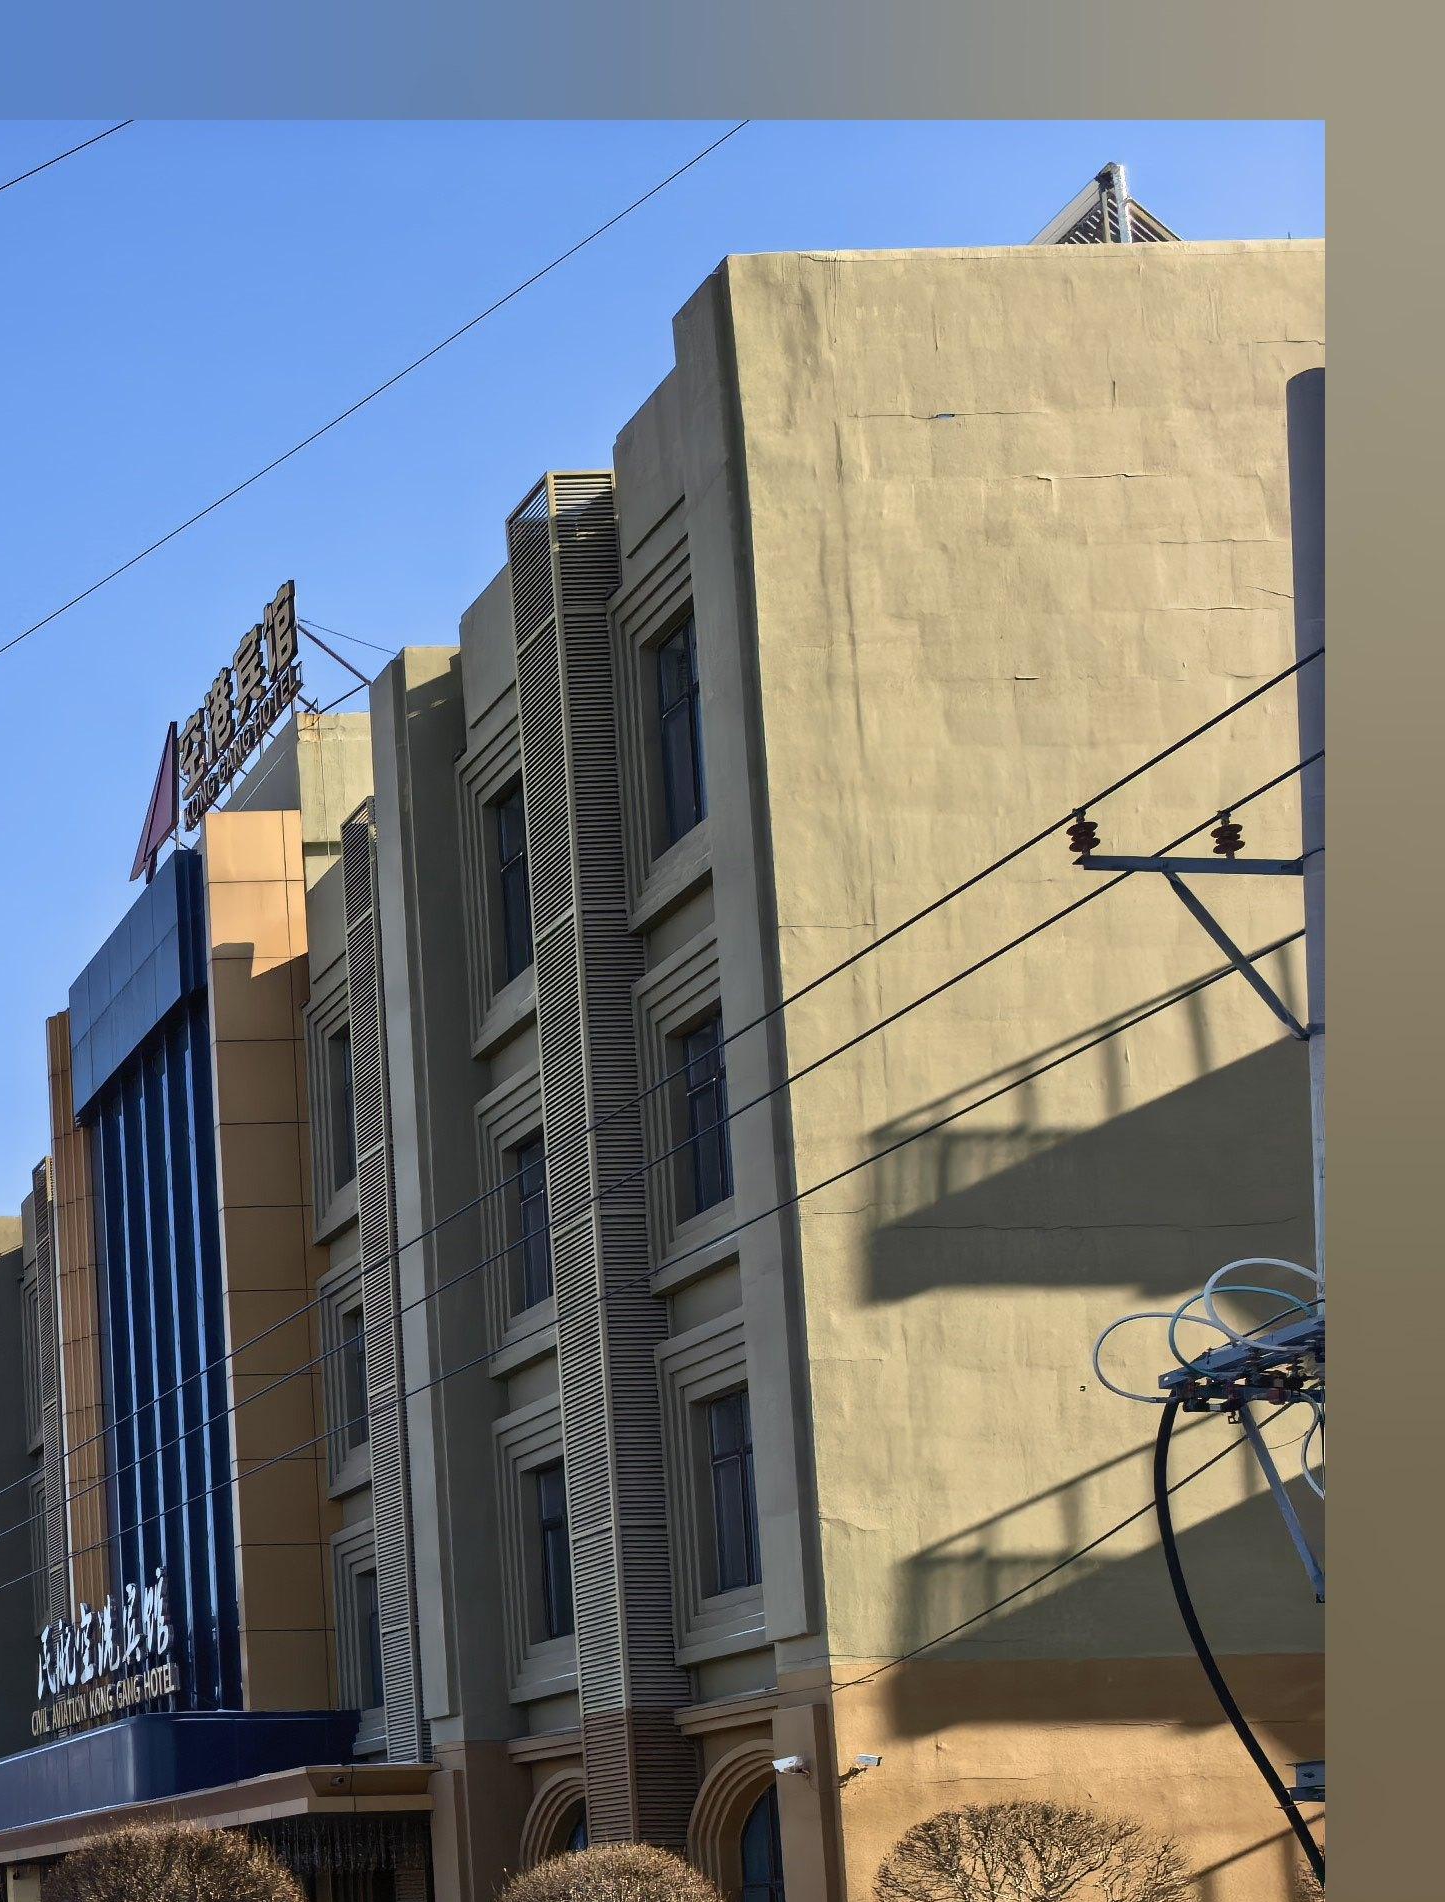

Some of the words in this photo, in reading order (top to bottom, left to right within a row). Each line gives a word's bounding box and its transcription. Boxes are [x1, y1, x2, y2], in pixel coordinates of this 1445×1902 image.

[178, 580, 298, 800] 空港宾馆
[183, 774, 219, 832] KONG
[218, 727, 256, 785] GANG
[253, 666, 302, 739] HOTEL
[31, 1707, 50, 1736] CIVIL
[52, 1693, 86, 1730] AVIATION
[89, 1684, 113, 1718] KONG
[116, 1674, 142, 1709] GANG
[144, 1663, 175, 1702] HOTEL
